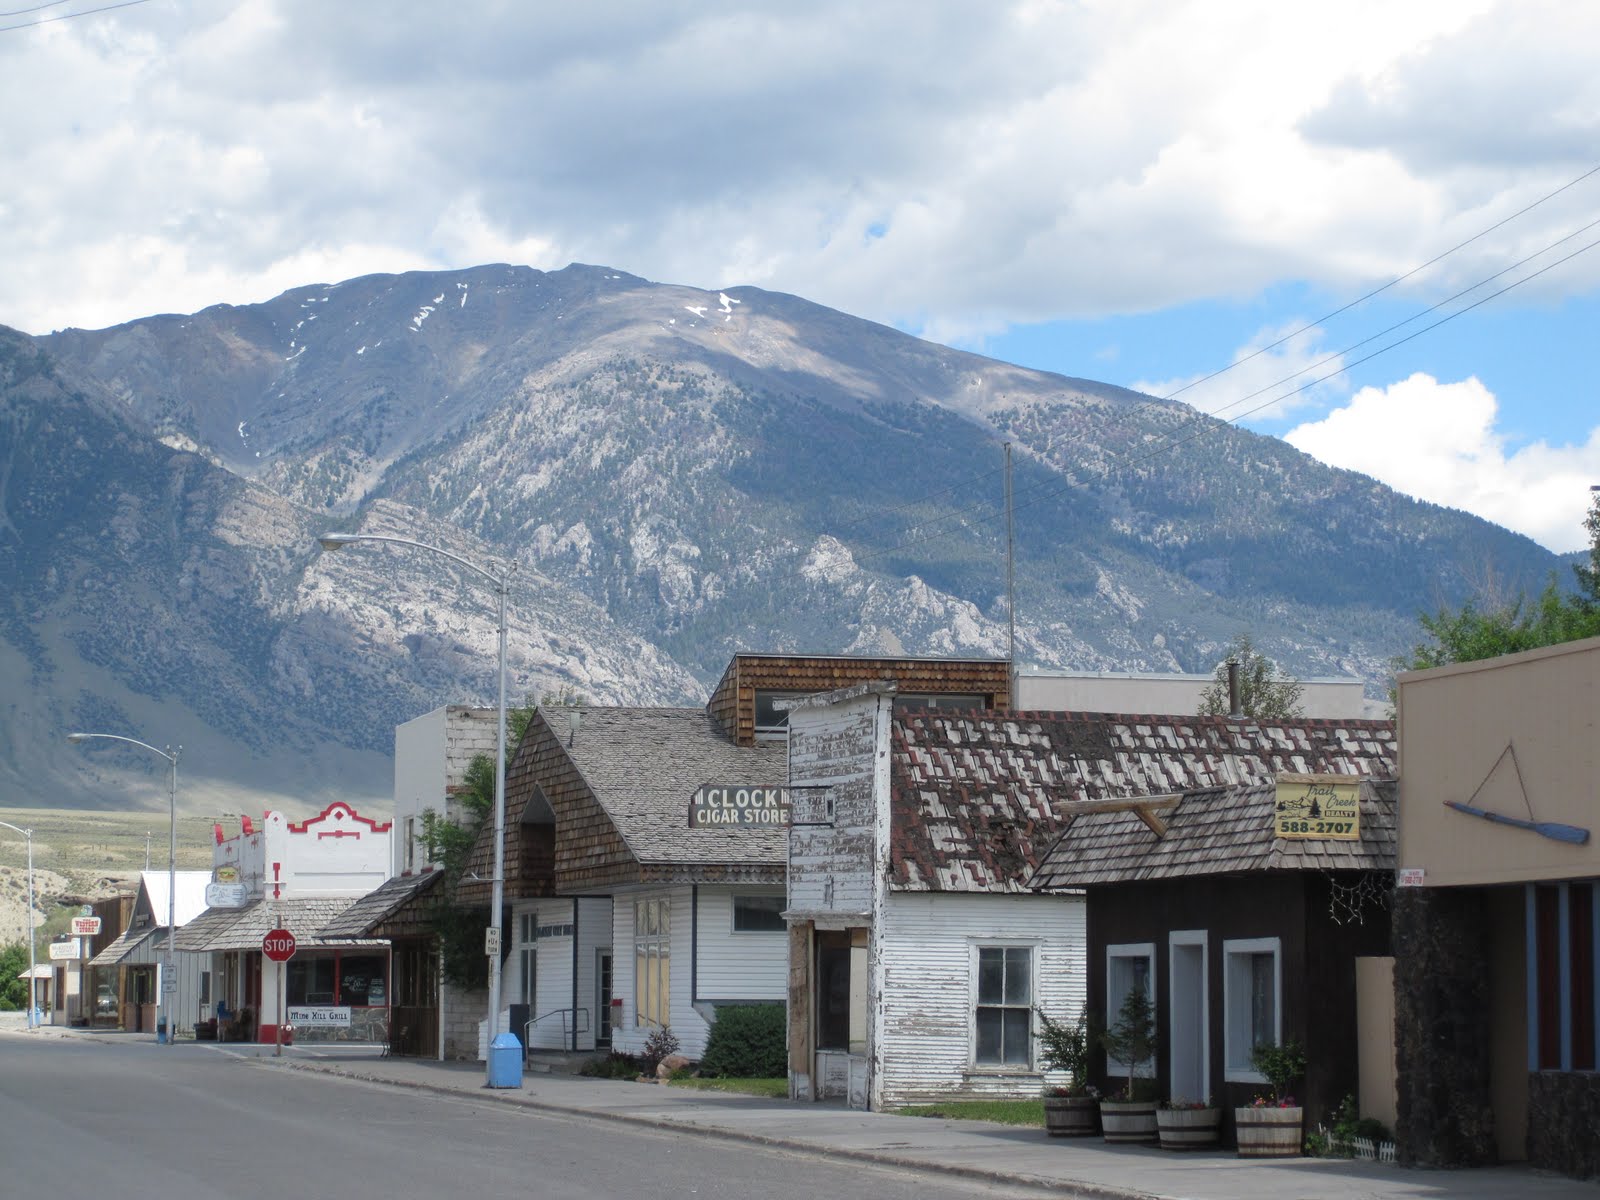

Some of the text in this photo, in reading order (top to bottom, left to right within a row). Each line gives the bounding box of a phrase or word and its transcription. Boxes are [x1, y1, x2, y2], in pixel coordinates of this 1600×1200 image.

[1306, 783, 1335, 797] Trail
[707, 789, 778, 808] CLOCK
[1326, 793, 1357, 809] Creek
[697, 809, 789, 823] CIGAR STORE
[1280, 821, 1354, 833] 588-2707
[265, 939, 294, 952] STOP
